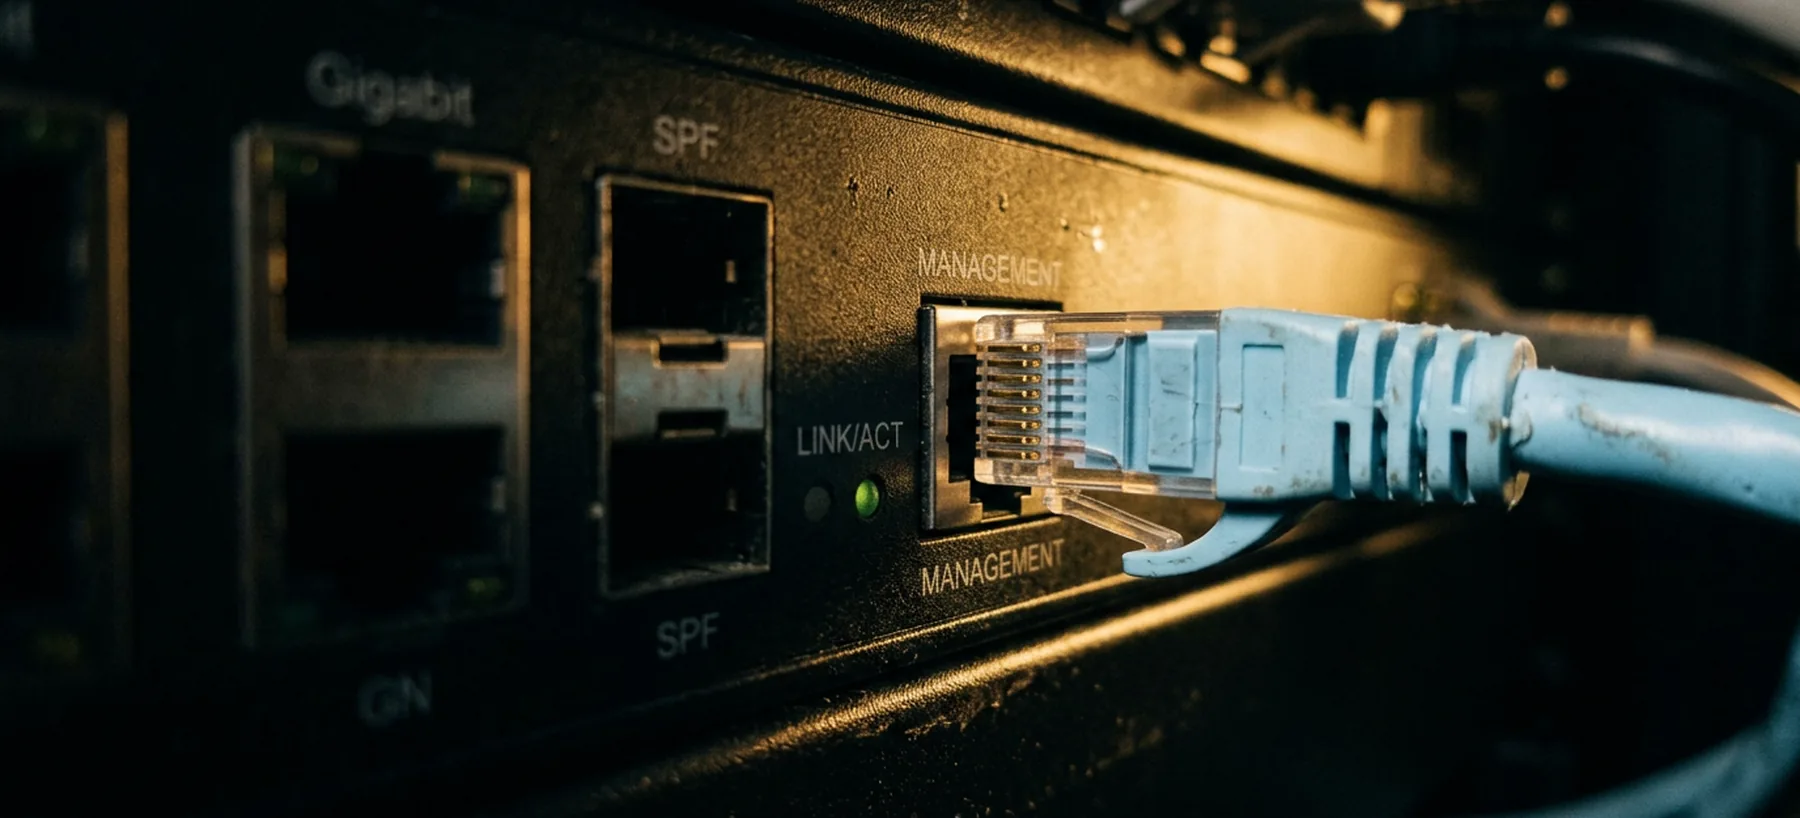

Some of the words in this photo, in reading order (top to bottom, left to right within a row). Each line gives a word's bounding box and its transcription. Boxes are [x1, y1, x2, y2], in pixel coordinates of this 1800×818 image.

[653, 115, 719, 159] SPF
[918, 248, 1063, 291] MANAGEMENT
[797, 421, 904, 456] LINK/ACT
[921, 538, 1065, 596] MANAGEMENT
[656, 611, 720, 660] SPF
